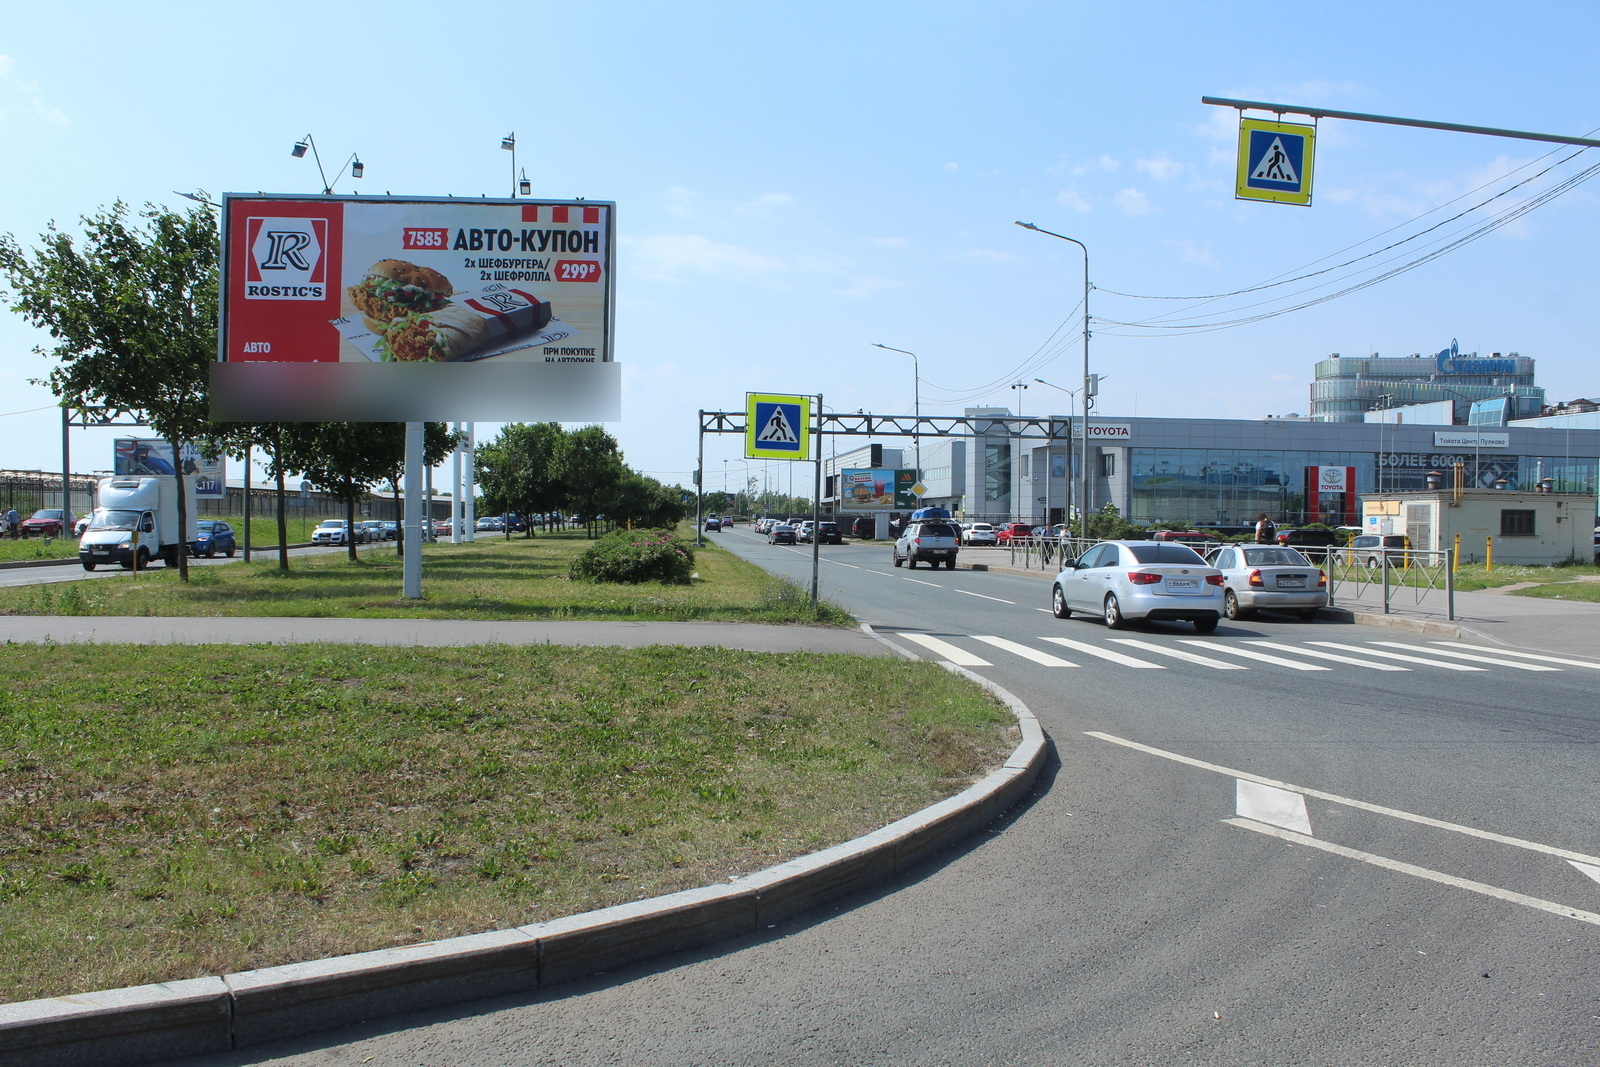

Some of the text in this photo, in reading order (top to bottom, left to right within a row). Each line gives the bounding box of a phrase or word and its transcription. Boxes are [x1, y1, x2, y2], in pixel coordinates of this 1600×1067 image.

[408, 231, 442, 246] 7585
[453, 228, 599, 253] АВТО-КУПОН
[261, 231, 310, 270] R
[494, 271, 551, 282] ШЕФРОЛЛА
[248, 286, 322, 297] ROSTIC'S
[243, 341, 271, 353] АВТО
[543, 347, 596, 356] ПРИ ПОКУПКЕ
[1087, 426, 1129, 436] TOYOTA
[1480, 438, 1506, 446] Пулково
[1378, 454, 1464, 468] БОЛЕЕ 6000
[201, 481, 215, 490] 117
